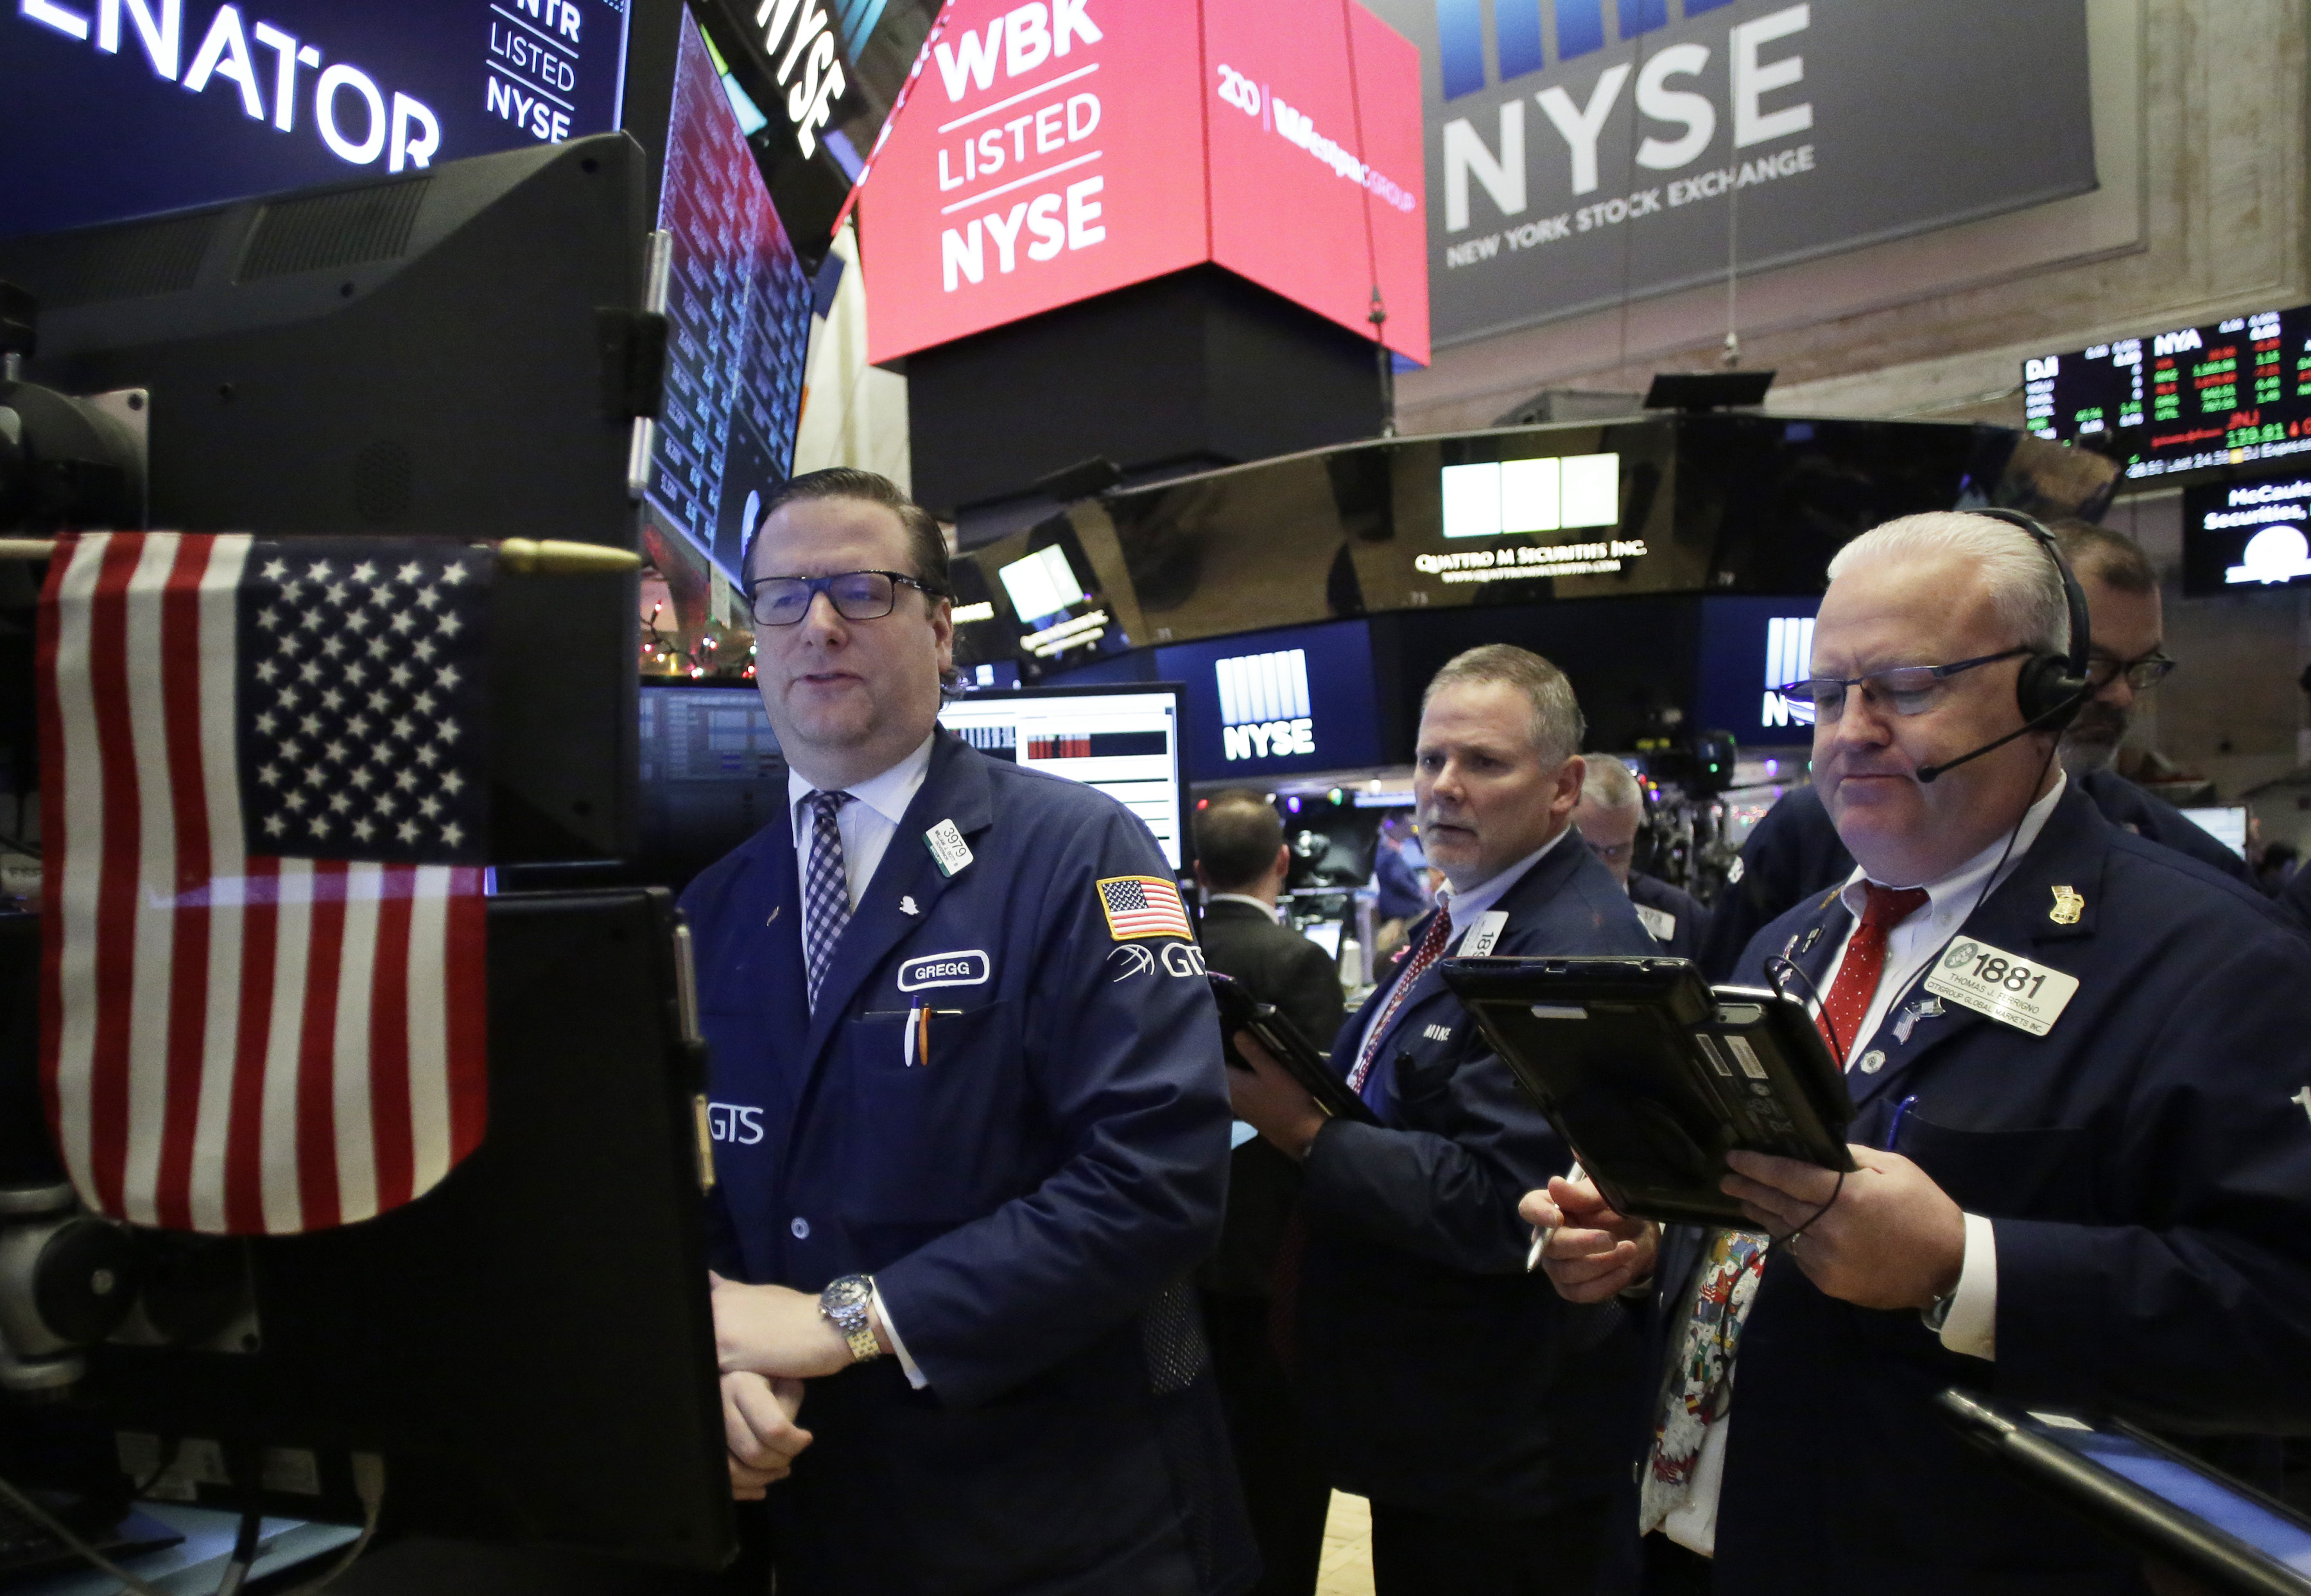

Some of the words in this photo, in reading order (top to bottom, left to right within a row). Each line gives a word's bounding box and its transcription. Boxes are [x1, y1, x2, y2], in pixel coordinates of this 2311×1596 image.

[490, 22, 575, 92] LISTED
[933, 0, 1104, 103] WBK
[21, 0, 440, 173] NATOR
[487, 75, 571, 144] NYSE
[1218, 64, 1261, 116] 200
[938, 92, 1101, 191] LISTED
[1443, 4, 1813, 232] NYSE
[1446, 233, 1501, 269] NEW
[1503, 213, 1571, 252] YORK
[1575, 187, 1662, 233] STOCK
[1666, 144, 1816, 209] EXCHANGE
[941, 175, 1105, 292] NYSE
[1496, 548, 1515, 566] M
[1223, 718, 1315, 761] NYSE
[944, 828, 966, 857] 3979
[915, 962, 970, 980] GREGG
[1951, 973, 1986, 993] THOMAS
[1996, 993, 2040, 1014] FERRIGNO
[1972, 953, 2047, 999] 1881
[1927, 981, 1964, 999] CITIGROUP
[1964, 996, 1991, 1013] GLOBAL
[1994, 1007, 2029, 1027] MARKETS
[1423, 1024, 1451, 1041] MIKE
[707, 1102, 764, 1145] GTS
